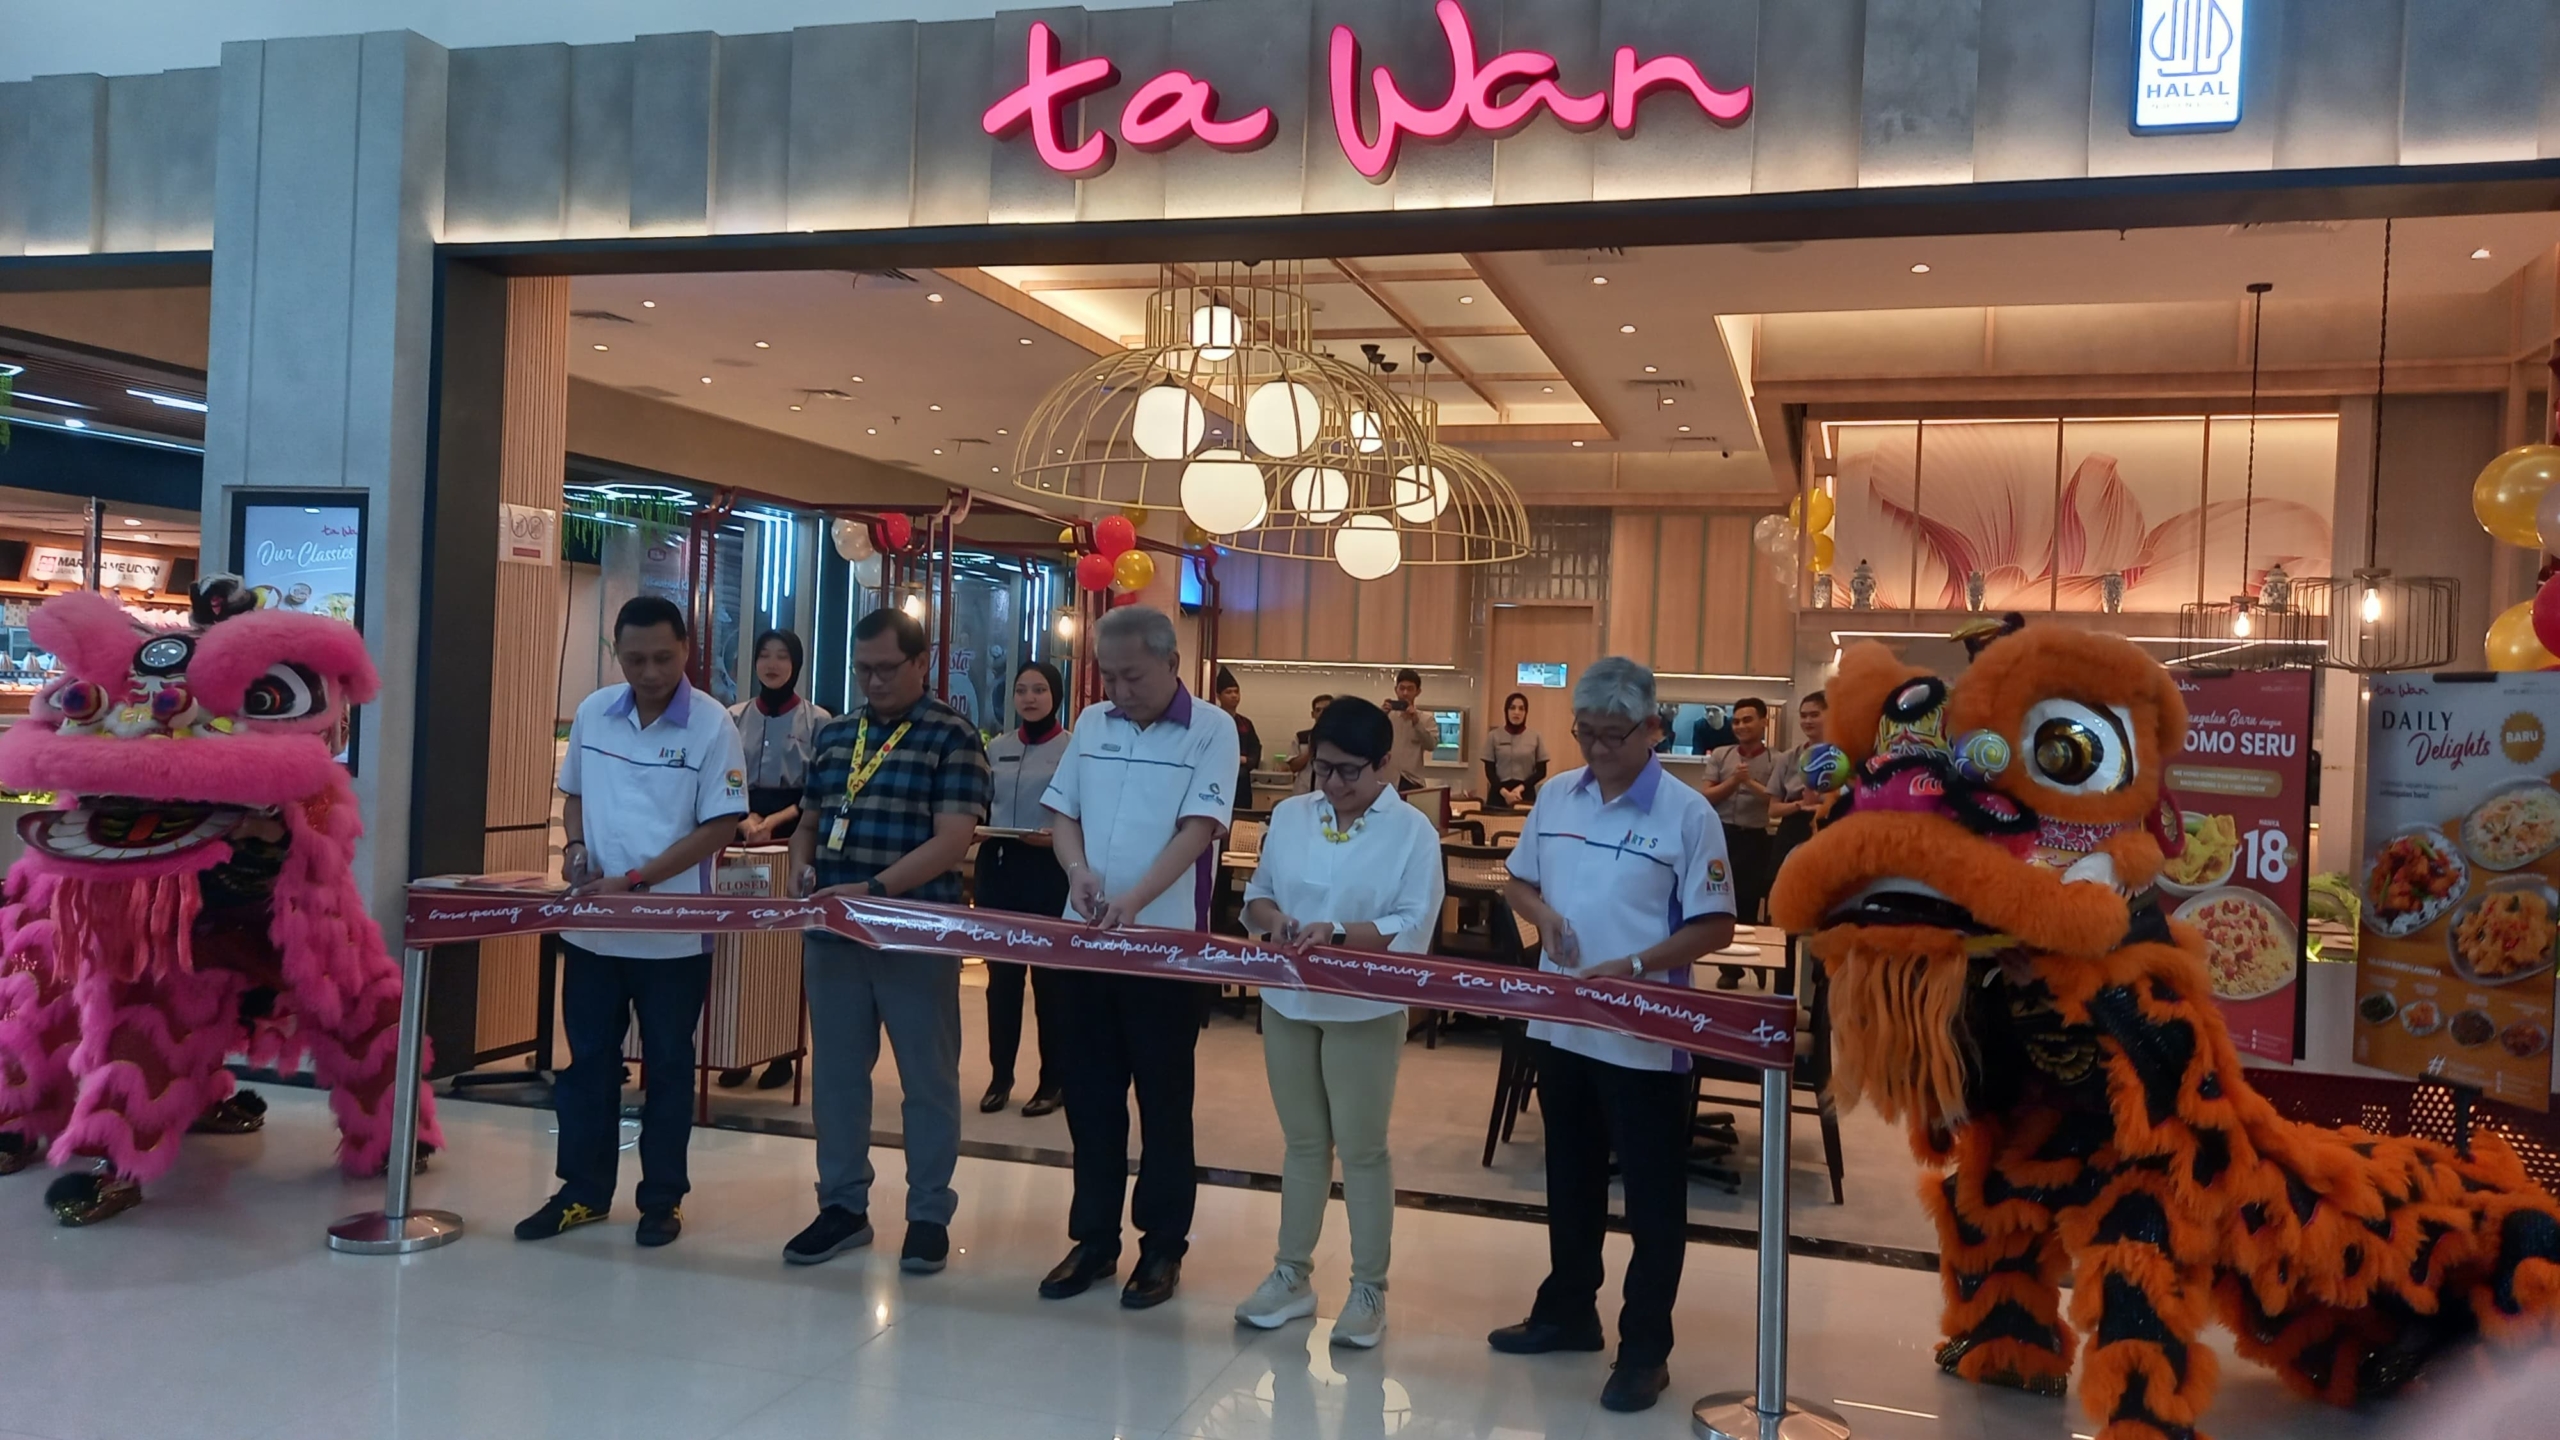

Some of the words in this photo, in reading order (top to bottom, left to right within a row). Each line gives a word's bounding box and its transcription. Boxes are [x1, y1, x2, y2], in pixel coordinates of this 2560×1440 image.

[982, 21, 1278, 179] ta
[1329, 0, 1752, 184] Wan
[2146, 80, 2230, 99] HALAL
[342, 525, 359, 538] Wa
[256, 539, 294, 567] Our
[297, 540, 355, 568] Classics
[57, 556, 126, 573] MARAME
[2374, 682, 2396, 696] ta
[2399, 682, 2430, 698] Wan
[2187, 710, 2227, 729] angatan
[2228, 708, 2257, 728] Baru
[2382, 710, 2453, 731] DAILY
[2184, 729, 2236, 755] OMO
[2240, 731, 2297, 758] SERU
[2505, 730, 2539, 744] BARU
[2407, 729, 2492, 771] Delights
[2243, 829, 2289, 883] 18
[718, 880, 769, 892] CLOSED
[966, 923, 1002, 942] ta
[1006, 928, 1053, 948] Wan
[1198, 942, 1235, 962] ta
[1241, 946, 1290, 966] Wan
[1452, 971, 1493, 987] ta
[1500, 977, 1555, 996] Wan
[1575, 986, 1632, 1008] Grand
[1633, 993, 1713, 1033] Opening
[1752, 1018, 1791, 1045] ta
